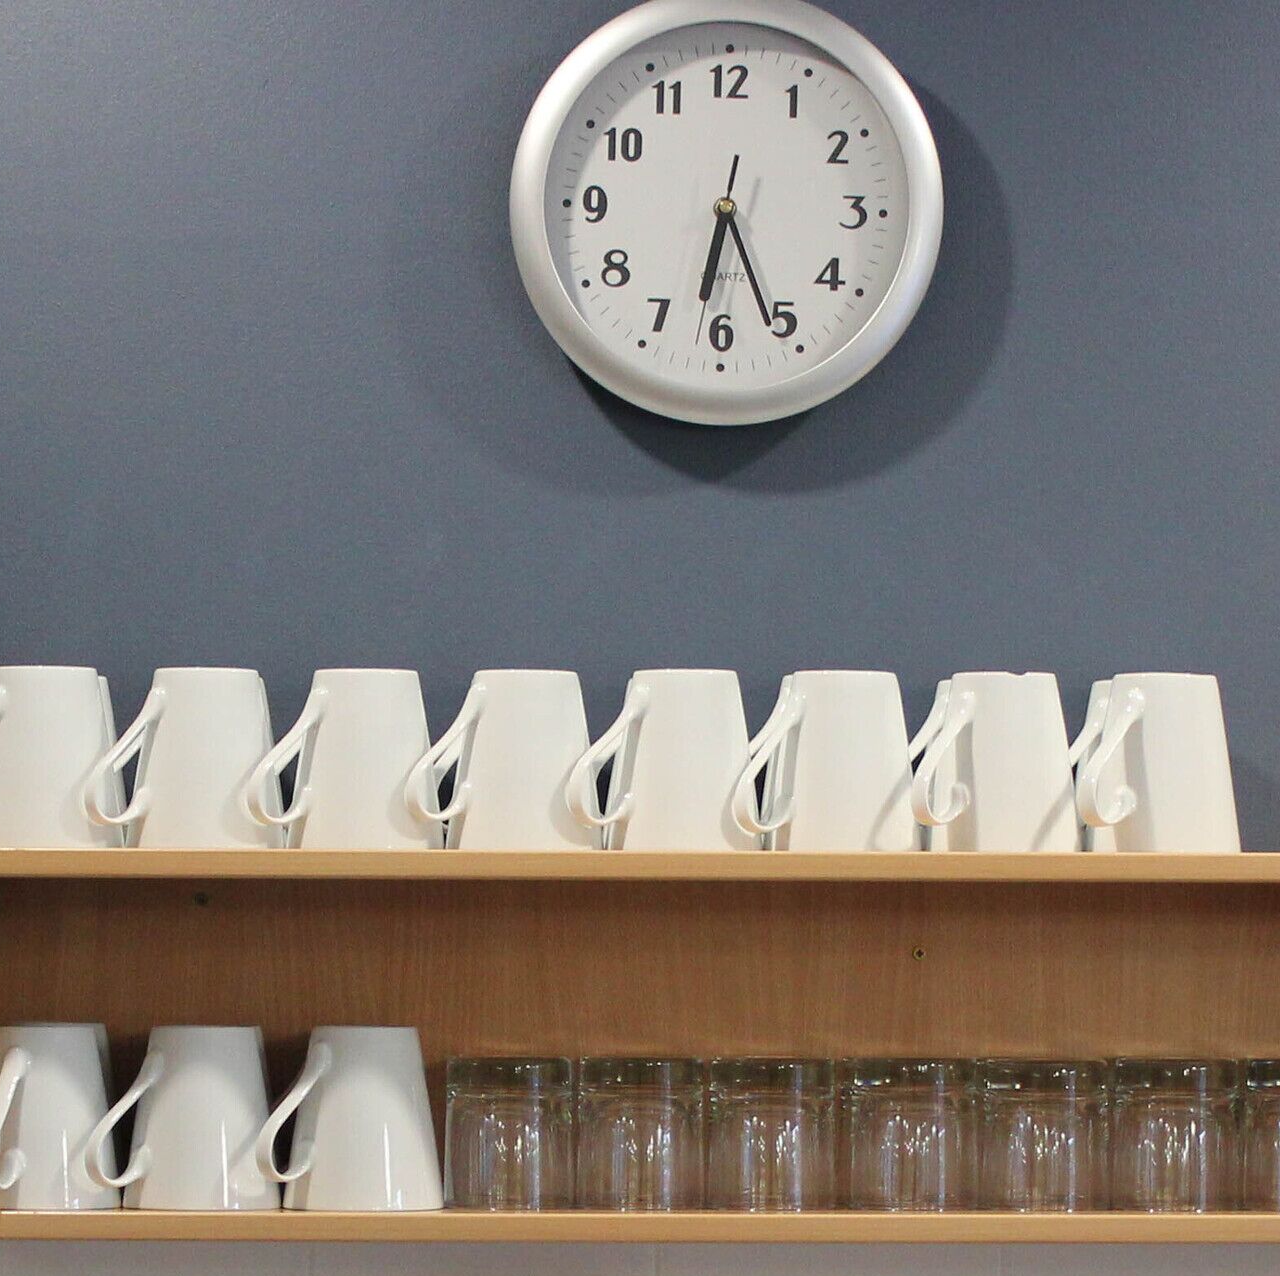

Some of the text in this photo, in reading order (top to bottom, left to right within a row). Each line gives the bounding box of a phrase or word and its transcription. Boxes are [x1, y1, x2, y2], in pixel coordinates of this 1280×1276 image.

[652, 81, 682, 115] 11
[710, 65, 749, 99] 12
[784, 84, 799, 118] 1
[603, 128, 643, 162] 10
[826, 131, 850, 165] 2
[582, 185, 608, 223] 9
[839, 195, 868, 230] 3
[601, 249, 631, 288] 8
[701, 272, 746, 282] ARTZ
[814, 257, 846, 291] 4
[647, 298, 671, 332] 7
[770, 301, 798, 338] 5
[709, 314, 734, 353] 6
